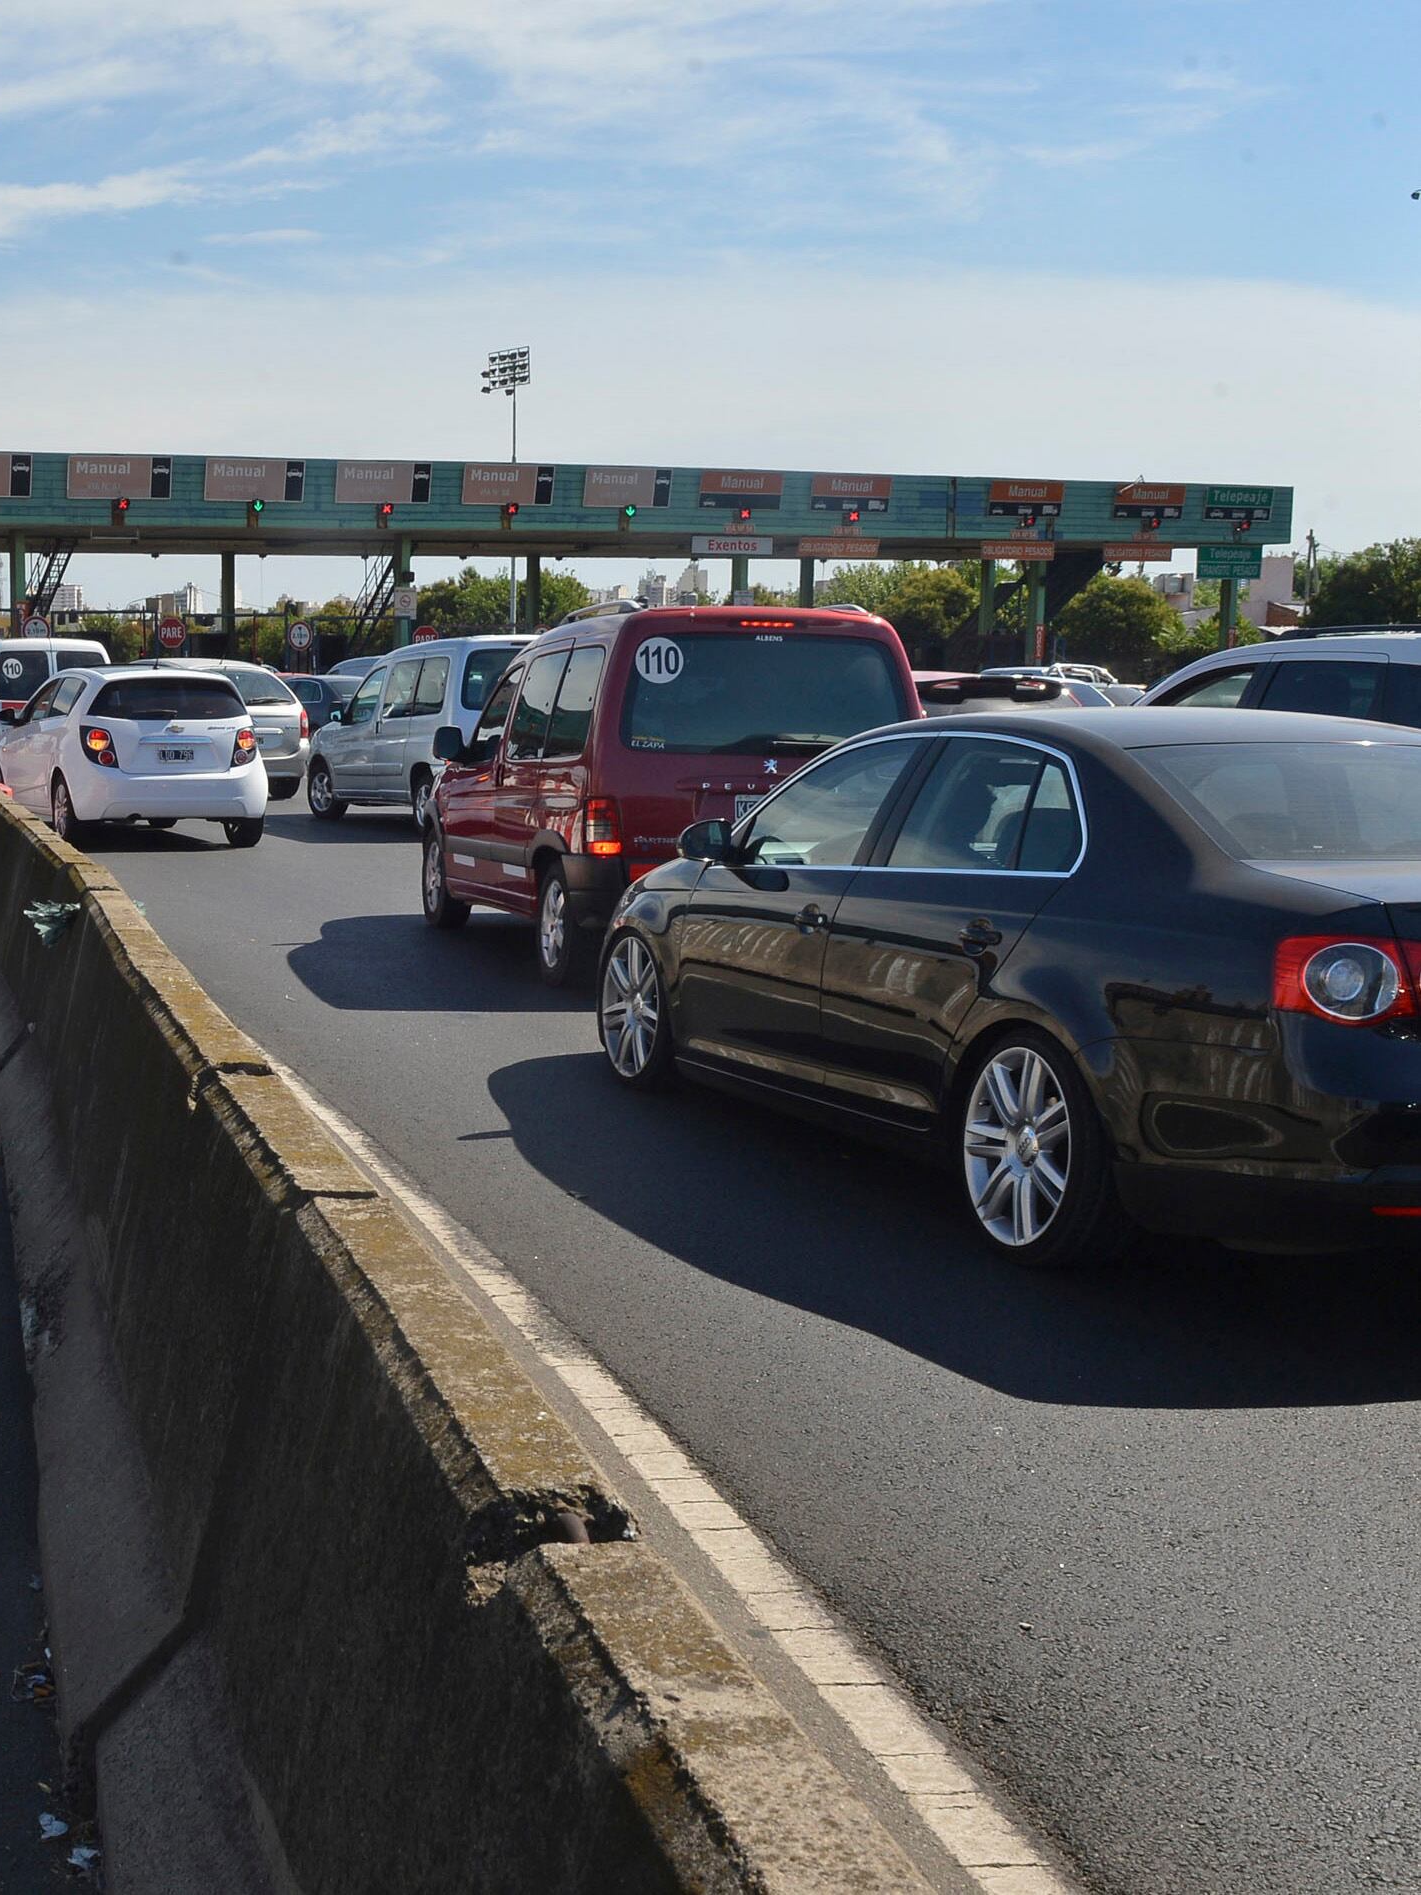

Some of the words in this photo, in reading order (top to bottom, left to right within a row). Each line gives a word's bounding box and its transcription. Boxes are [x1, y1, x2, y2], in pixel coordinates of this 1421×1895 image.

[76, 462, 130, 474] Manual
[213, 463, 266, 477] Manual
[344, 467, 394, 480] Manual
[471, 469, 519, 481] Manual
[592, 472, 638, 485] Manual
[721, 475, 764, 489] Manual
[831, 479, 873, 492] Manual
[1008, 484, 1047, 497] Manual
[1132, 488, 1169, 500] Manual
[1214, 489, 1268, 505] Telepeaje
[707, 540, 757, 552] Exentos
[1209, 548, 1252, 562] Telepeaje
[161, 627, 183, 639] PARE
[639, 646, 679, 675] 110
[4, 662, 21, 676] 110
[642, 741, 666, 749] ZAPA
